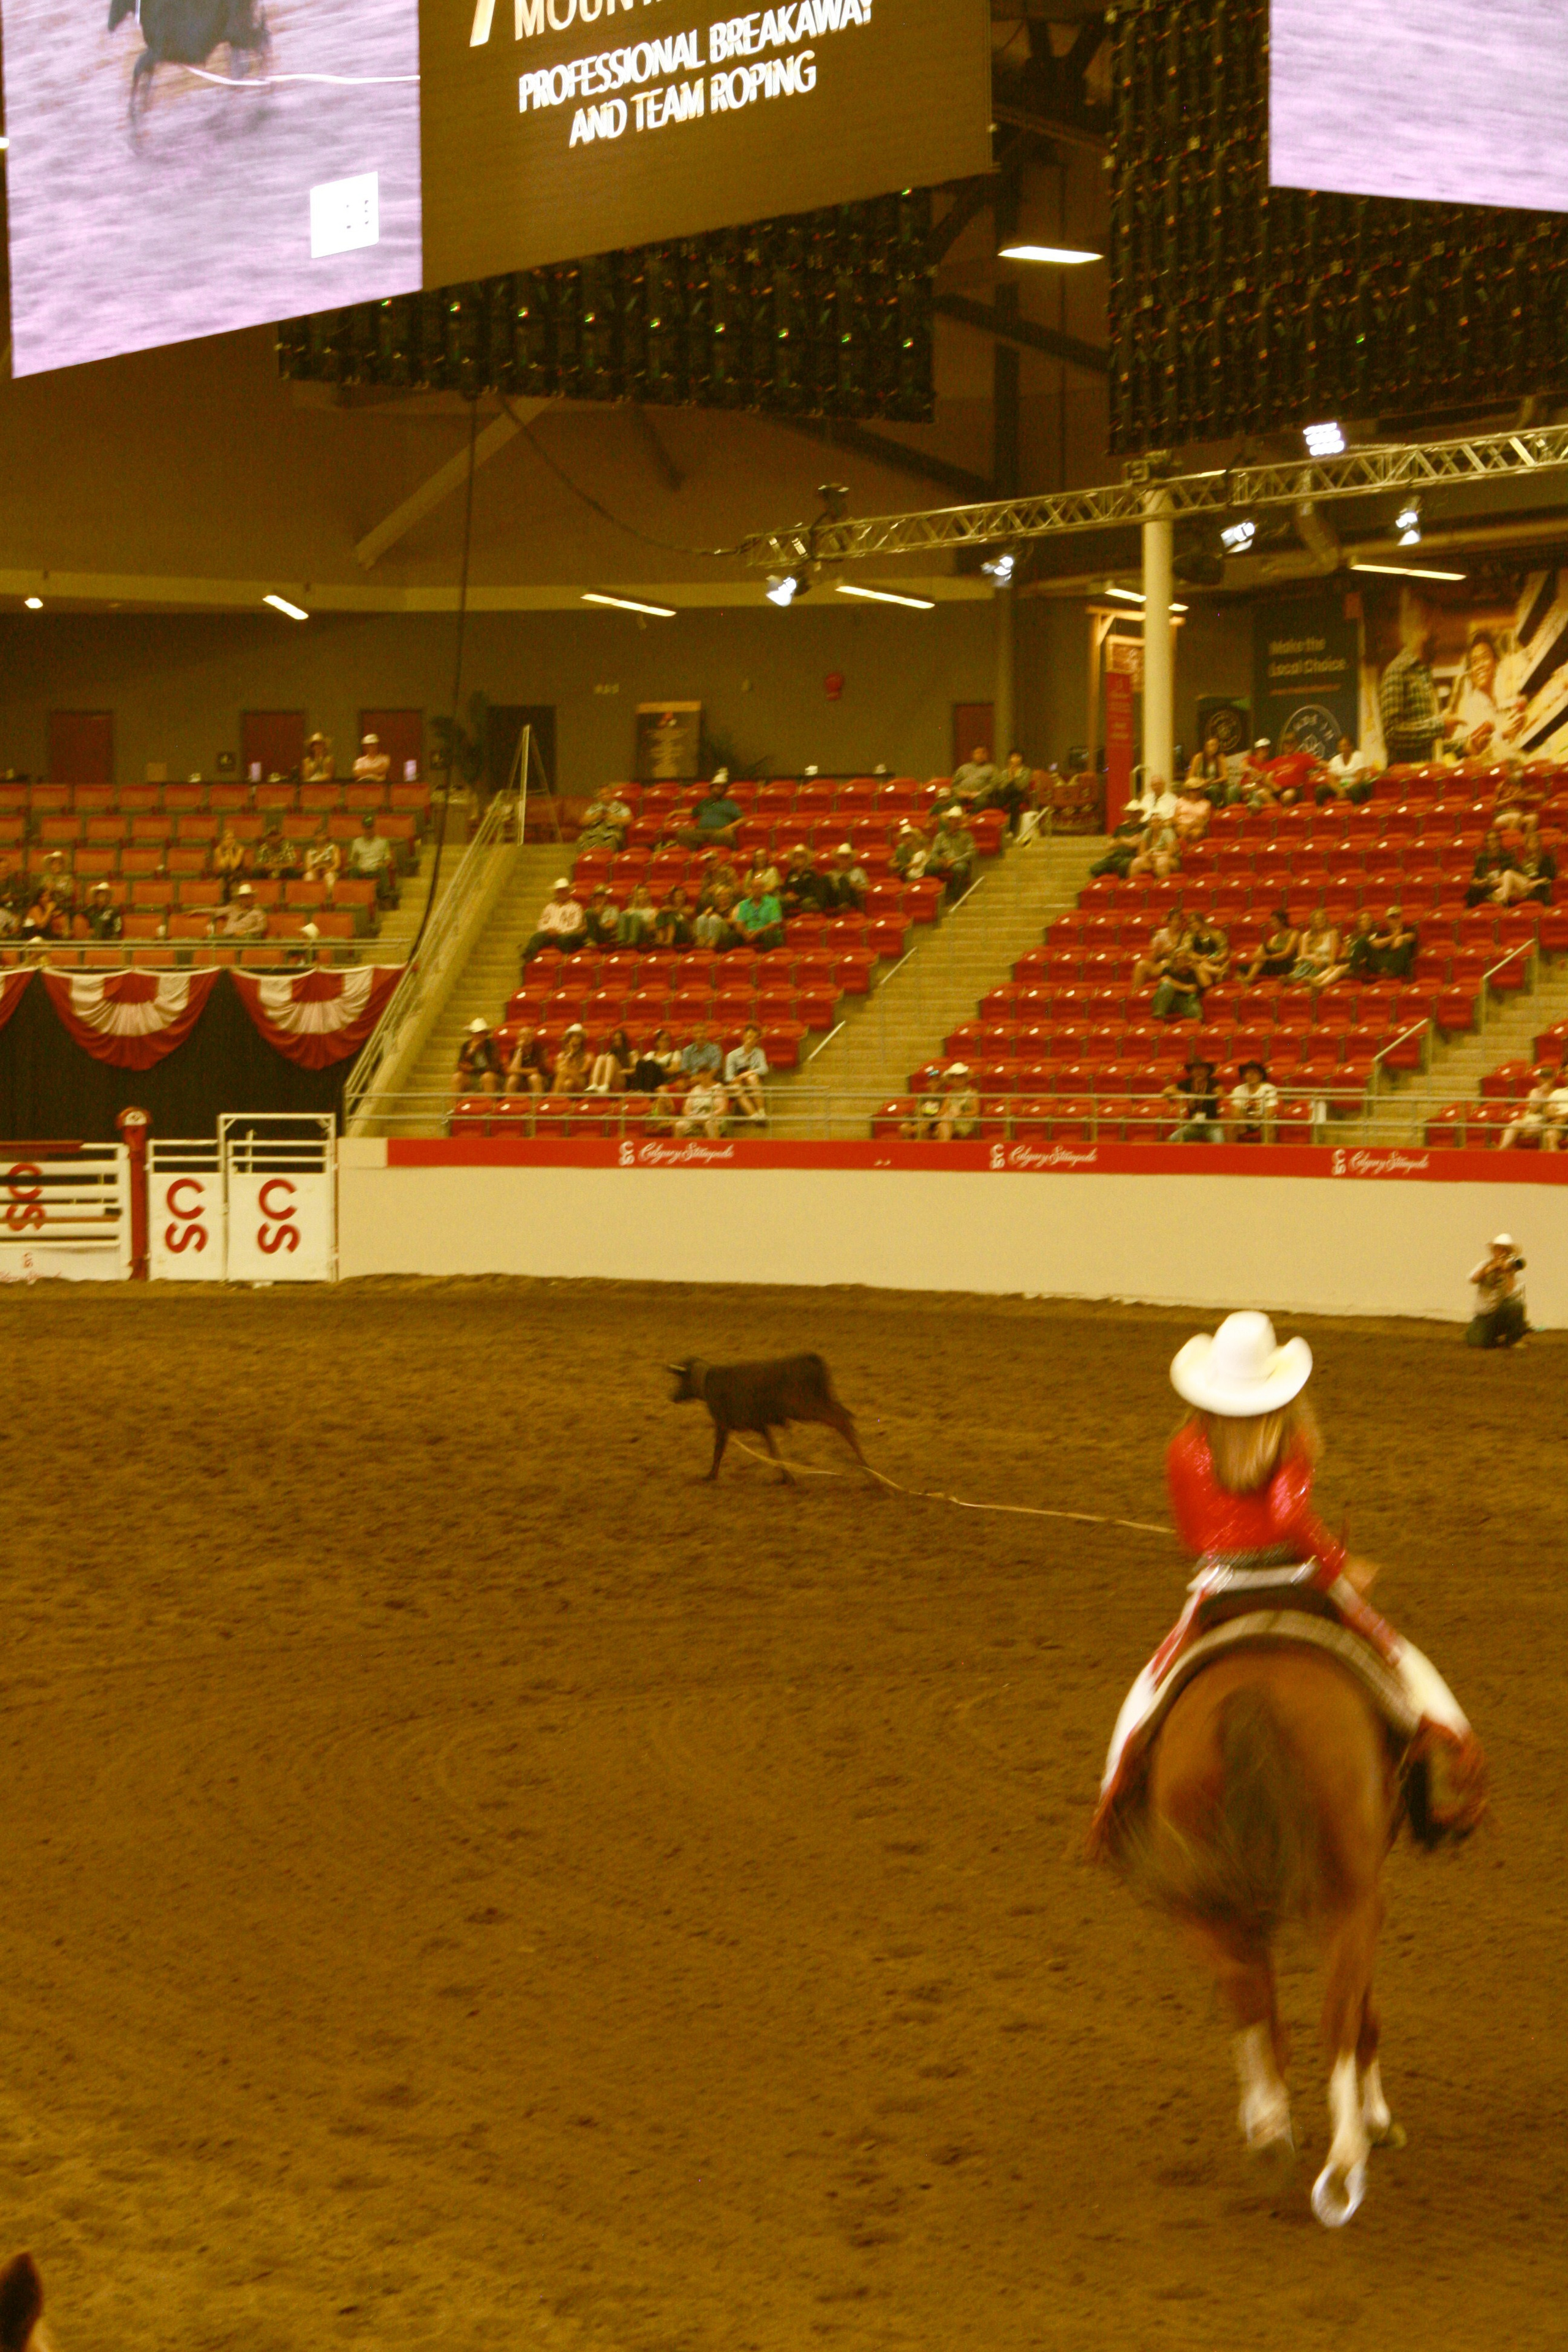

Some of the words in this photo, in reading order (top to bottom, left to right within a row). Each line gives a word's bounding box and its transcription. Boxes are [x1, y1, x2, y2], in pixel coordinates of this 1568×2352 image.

[519, 29, 706, 113] PROFESSIONAL
[709, 0, 873, 64] BREAKAWAY
[569, 98, 627, 148] AND
[630, 78, 704, 132] TEAM
[710, 50, 817, 114] ROPING
